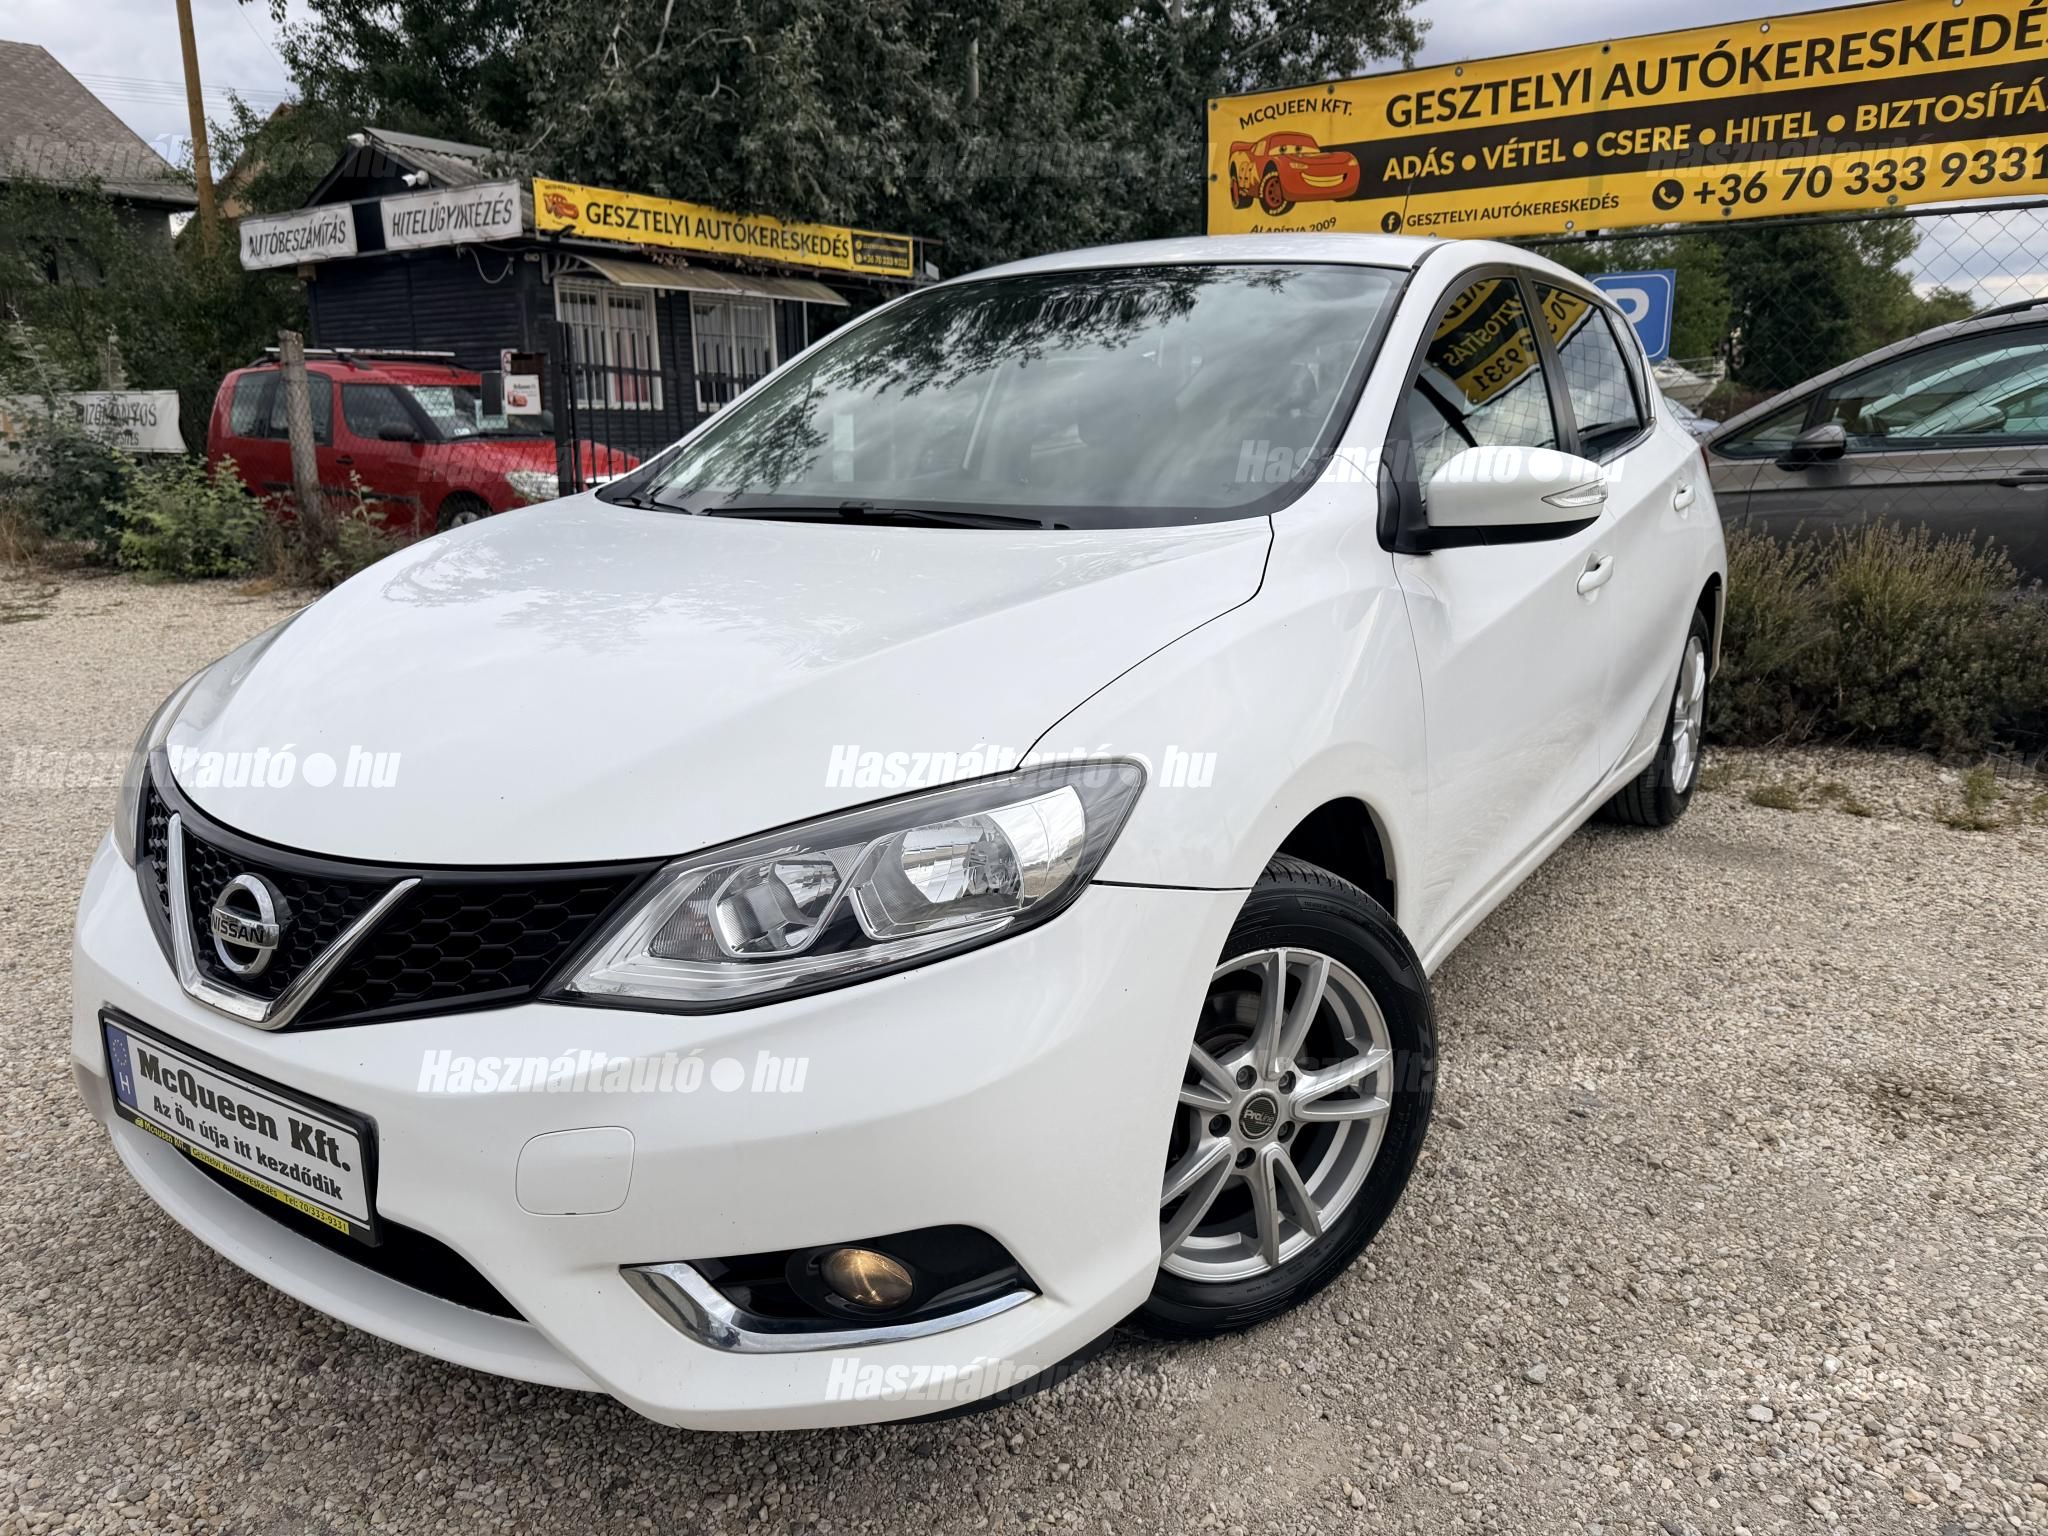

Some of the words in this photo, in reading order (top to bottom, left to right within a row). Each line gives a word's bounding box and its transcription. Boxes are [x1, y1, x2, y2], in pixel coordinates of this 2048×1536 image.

[1386, 67, 1592, 128] GESZTELYI
[1601, 0, 2048, 100] AUTÓKERESKEDÉ
[1239, 98, 1317, 129] MCQUEEN
[1321, 98, 1352, 116] KFT.
[1382, 147, 1454, 182] ADÁS
[1482, 133, 1566, 170] VÉTEL
[1596, 123, 1691, 156] CSERE
[1725, 111, 1818, 145] HITEL
[1855, 77, 2048, 132] BIZTOSÍTÁ
[1693, 171, 1768, 206] +36
[1782, 165, 1833, 201] 70
[1844, 156, 1926, 195] 333
[392, 192, 513, 237] HITELÜGYINTÉZÉS
[586, 202, 690, 236] GESZTELYI
[695, 217, 849, 258] AUTÓKERESKEDÉS
[1309, 217, 1337, 233] 2009
[1407, 209, 1478, 227] GESZTELYI
[1480, 193, 1619, 220] AUTÓKERESKEDÉS
[212, 914, 264, 944] NISSAN
[119, 1072, 131, 1095] H
[137, 1047, 279, 1141] McQueen
[288, 1116, 351, 1172] Kft.
[153, 1095, 172, 1119] Az
[174, 1102, 195, 1132] Ön
[199, 1120, 230, 1149] útja
[233, 1136, 252, 1160] itt
[256, 1146, 343, 1200] kezdődik
